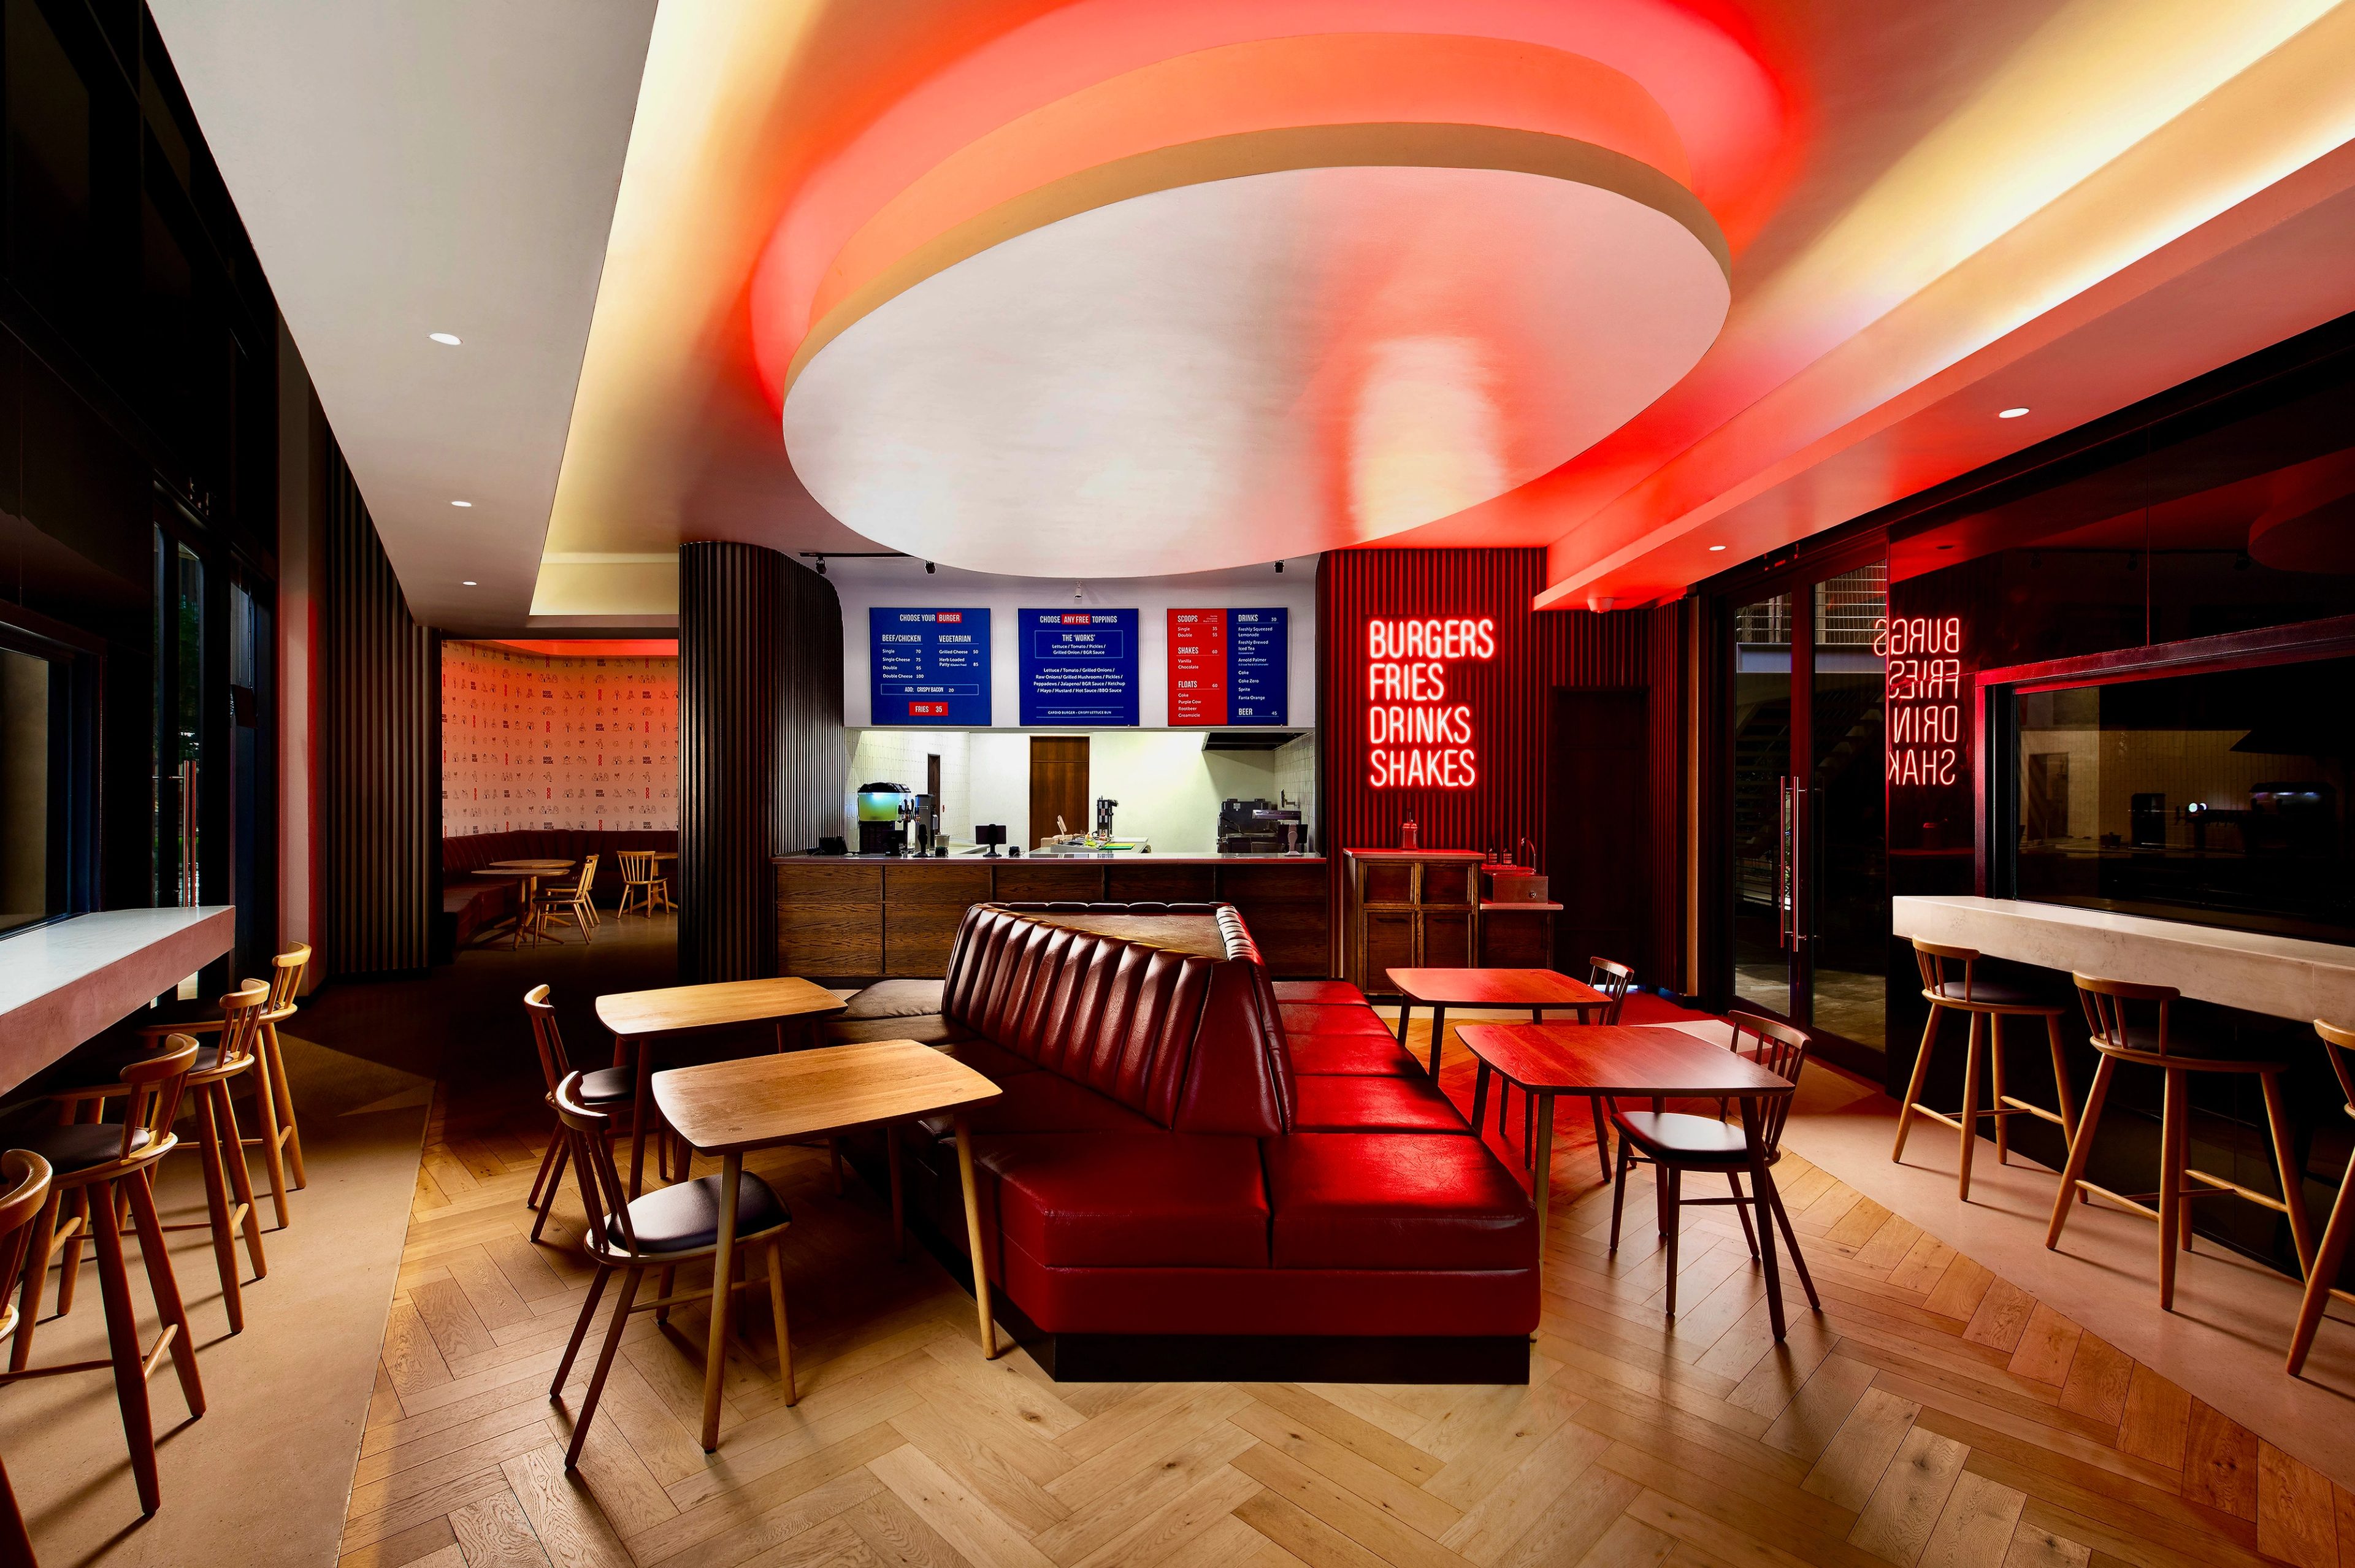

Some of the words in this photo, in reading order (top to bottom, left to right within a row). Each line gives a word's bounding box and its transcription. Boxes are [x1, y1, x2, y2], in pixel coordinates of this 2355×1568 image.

[1370, 619, 1495, 659] BURGERS
[1370, 663, 1445, 701] FRIES
[1370, 706, 1471, 744] DRINKS
[1370, 749, 1476, 787] SHAKES
